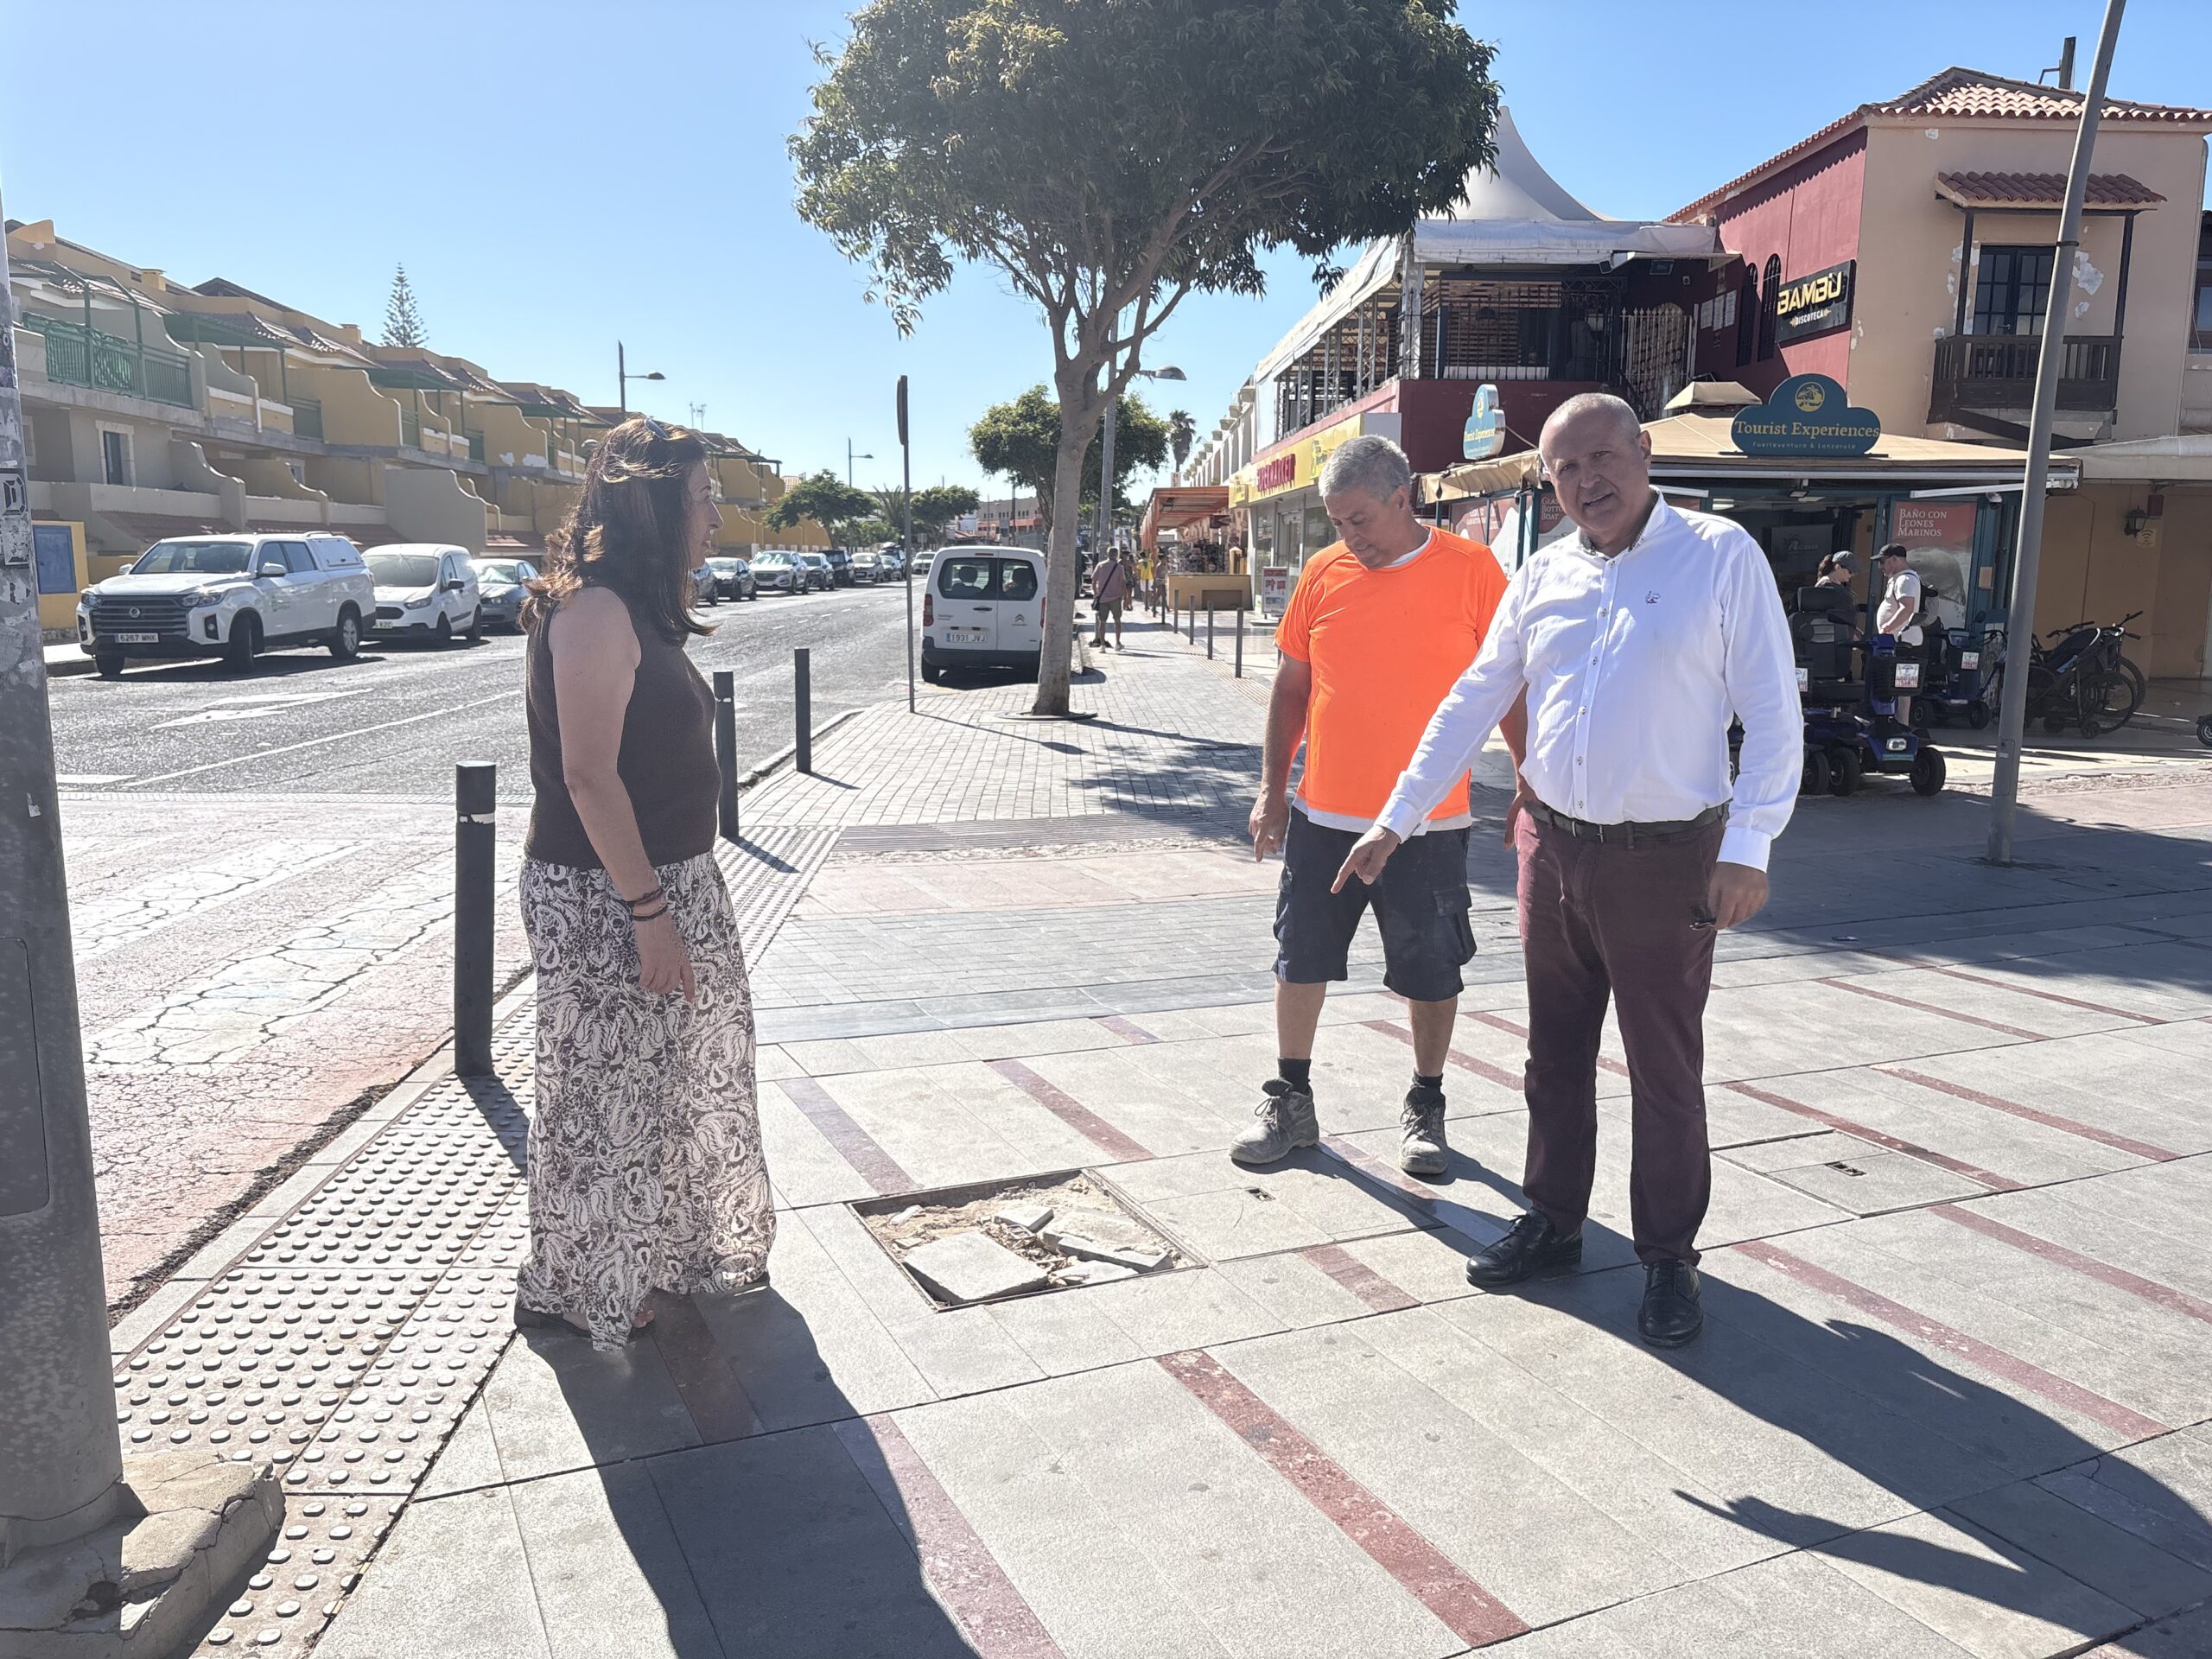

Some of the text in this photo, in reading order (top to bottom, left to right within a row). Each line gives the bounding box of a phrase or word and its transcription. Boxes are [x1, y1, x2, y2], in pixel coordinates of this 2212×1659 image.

[1795, 309, 1824, 326] DISCOTECA
[1734, 421, 1880, 439] Tourist Experiences
[1541, 497, 1559, 505] GLAS
[1928, 511, 1948, 519] CON
[1898, 518, 1935, 528] LEONES
[1897, 527, 1942, 537] MARINOS
